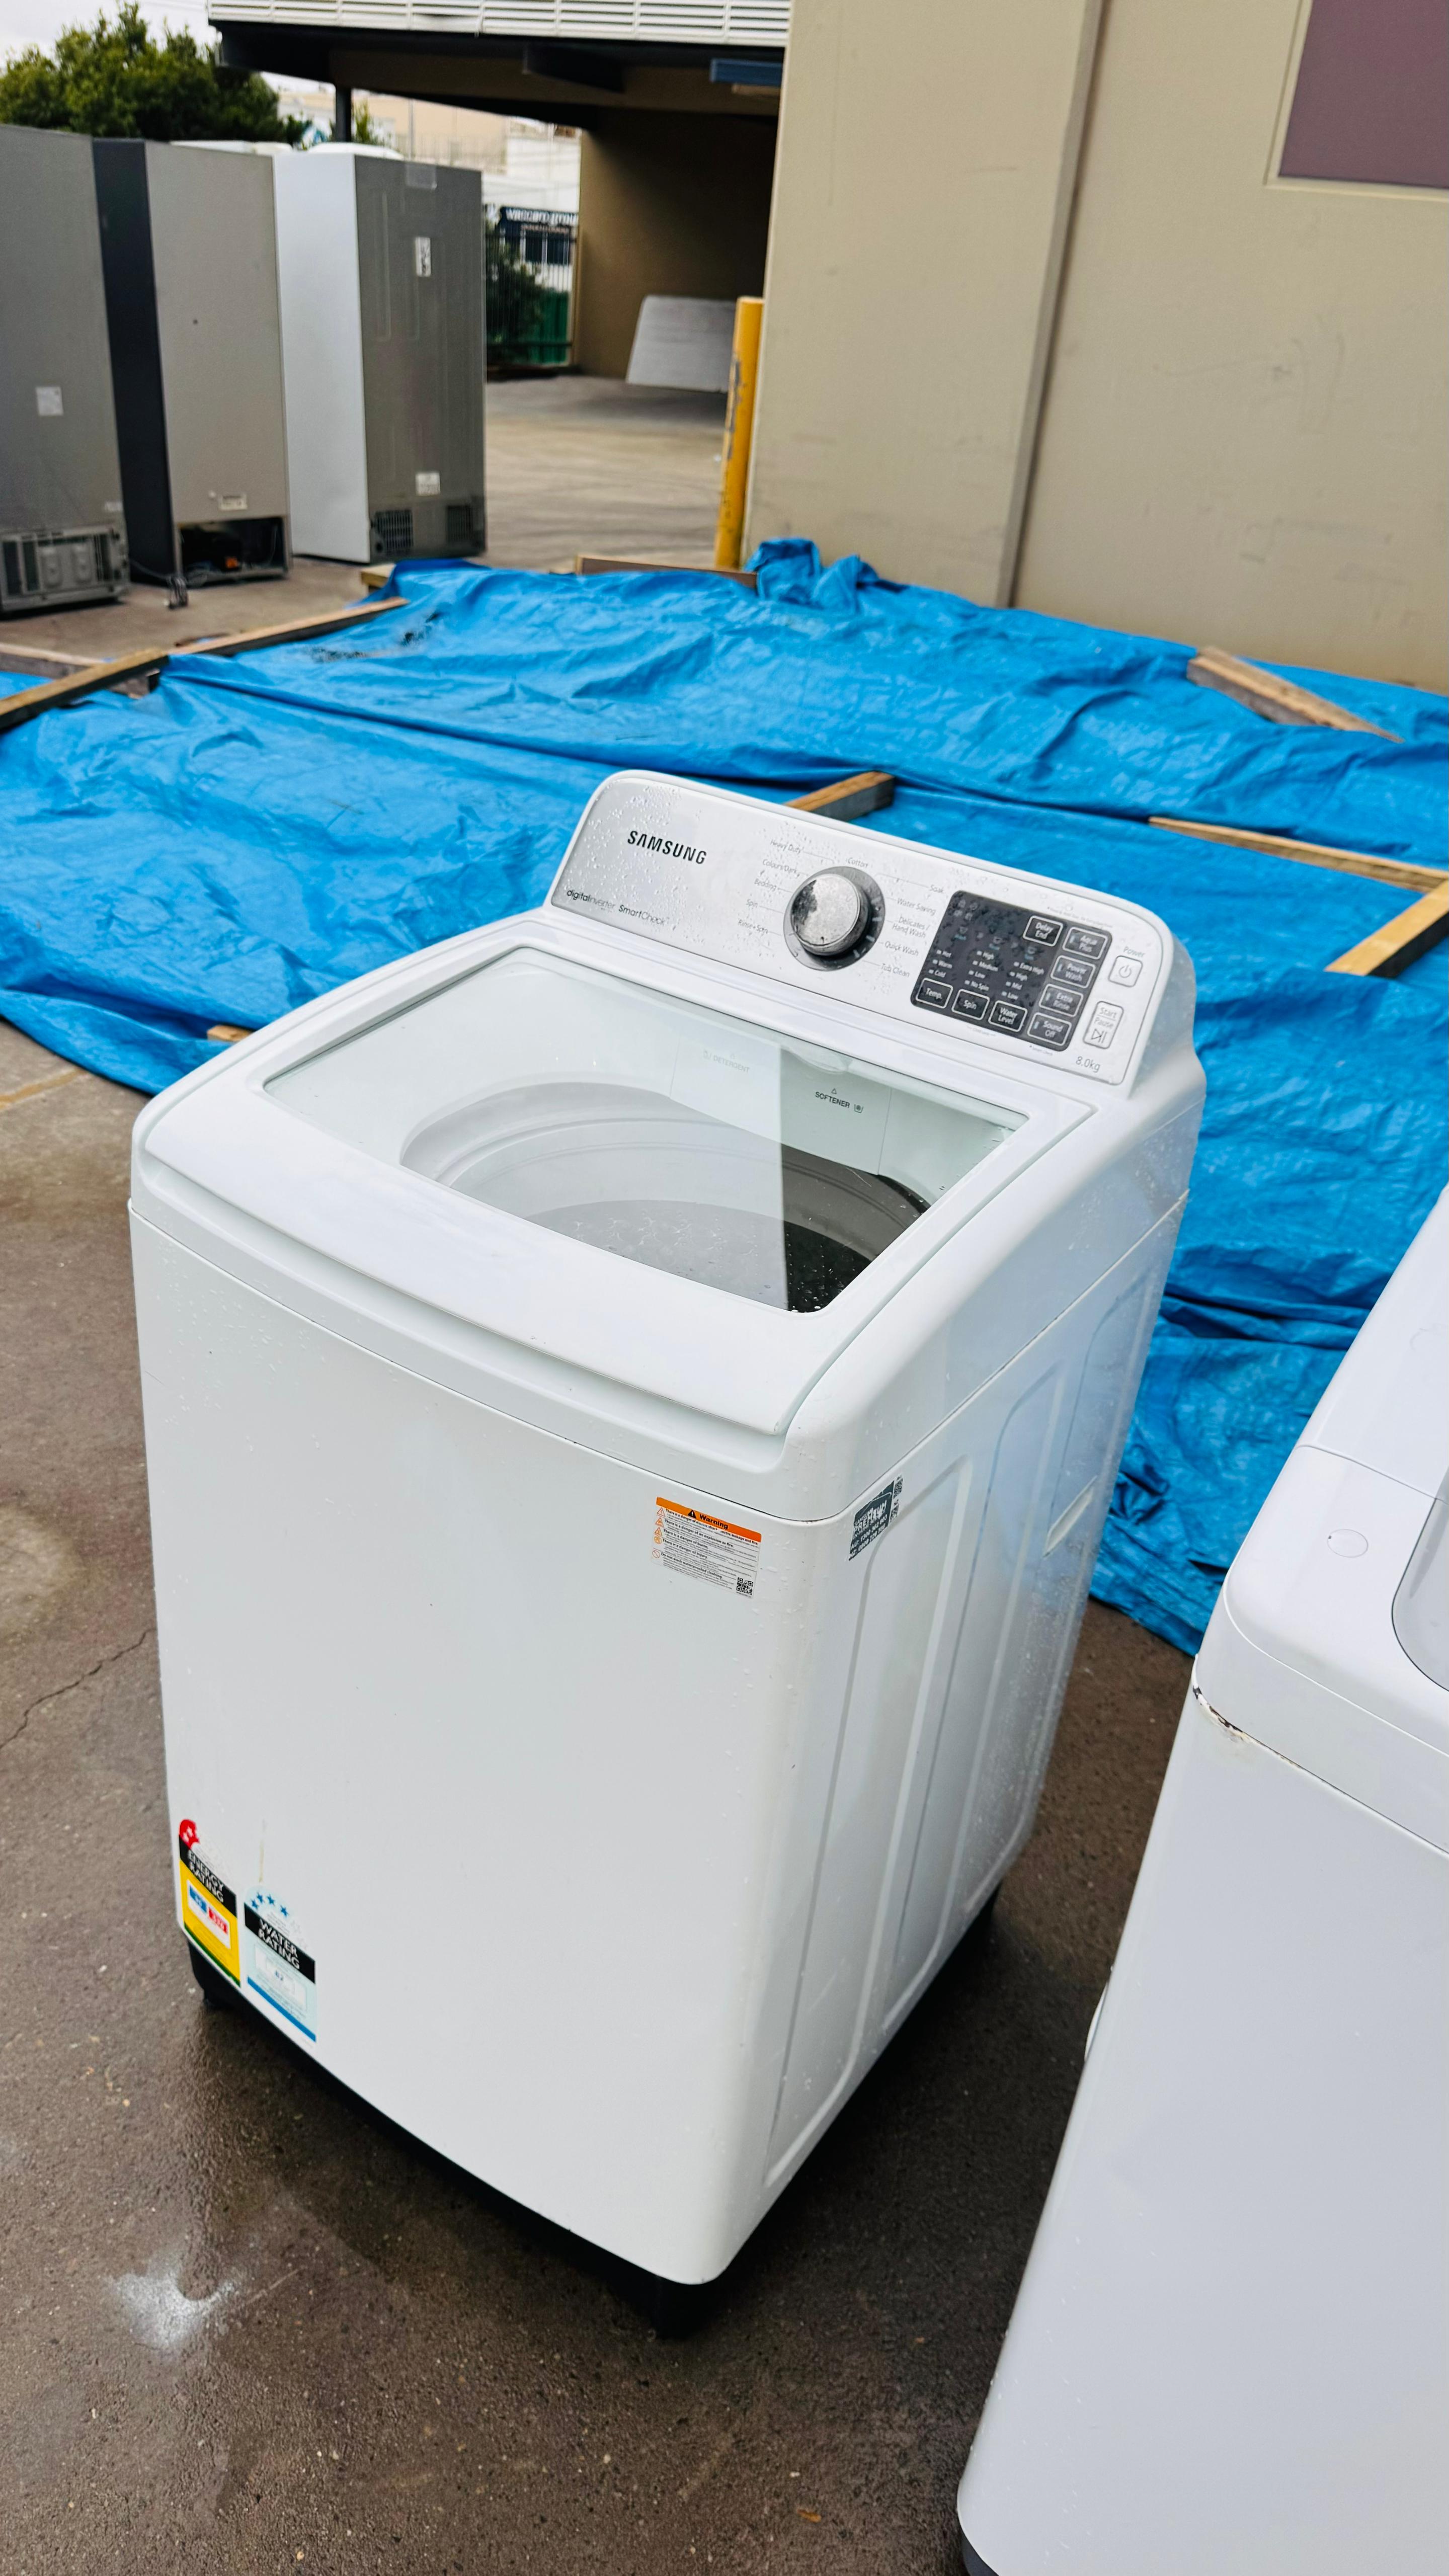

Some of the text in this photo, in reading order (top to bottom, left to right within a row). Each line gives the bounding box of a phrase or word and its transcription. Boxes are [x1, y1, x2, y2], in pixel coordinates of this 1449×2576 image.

[627, 830, 707, 865] SAMSUNG
[848, 857, 868, 868] Cotton
[755, 878, 777, 891] Bedding
[929, 885, 944, 894] Soak
[897, 898, 936, 916] Water Saving
[892, 924, 926, 938] Hand Wash
[1035, 922, 1055, 933] Delay
[1035, 930, 1049, 940] End
[885, 941, 919, 956] Quick Wash
[1123, 946, 1145, 957] Power
[881, 963, 910, 977] Tub Clean
[1067, 963, 1087, 975] Power
[926, 987, 942, 999] Temp.
[1057, 992, 1073, 1003] Extra
[963, 1000, 977, 1010] Spin
[1000, 1007, 1018, 1018] Water
[1099, 1007, 1117, 1019] Start
[998, 1014, 1014, 1025] Level
[1094, 1017, 1114, 1029] Pause
[1042, 1020, 1064, 1032] Sound
[1044, 1029, 1056, 1038] Off
[713, 1055, 750, 1073] DETERGENT
[1076, 1056, 1101, 1073] 8.0kg
[815, 1091, 850, 1108] SOFTENER
[700, 1514, 728, 1530] Warning
[680, 1535, 692, 1543] danger
[681, 1525, 694, 1534] danger
[704, 1534, 721, 1543] explosion
[679, 1545, 691, 1553] danger
[189, 1862, 224, 1903] RATING
[259, 1918, 298, 1958] WATER
[258, 1928, 300, 1969] RATING
